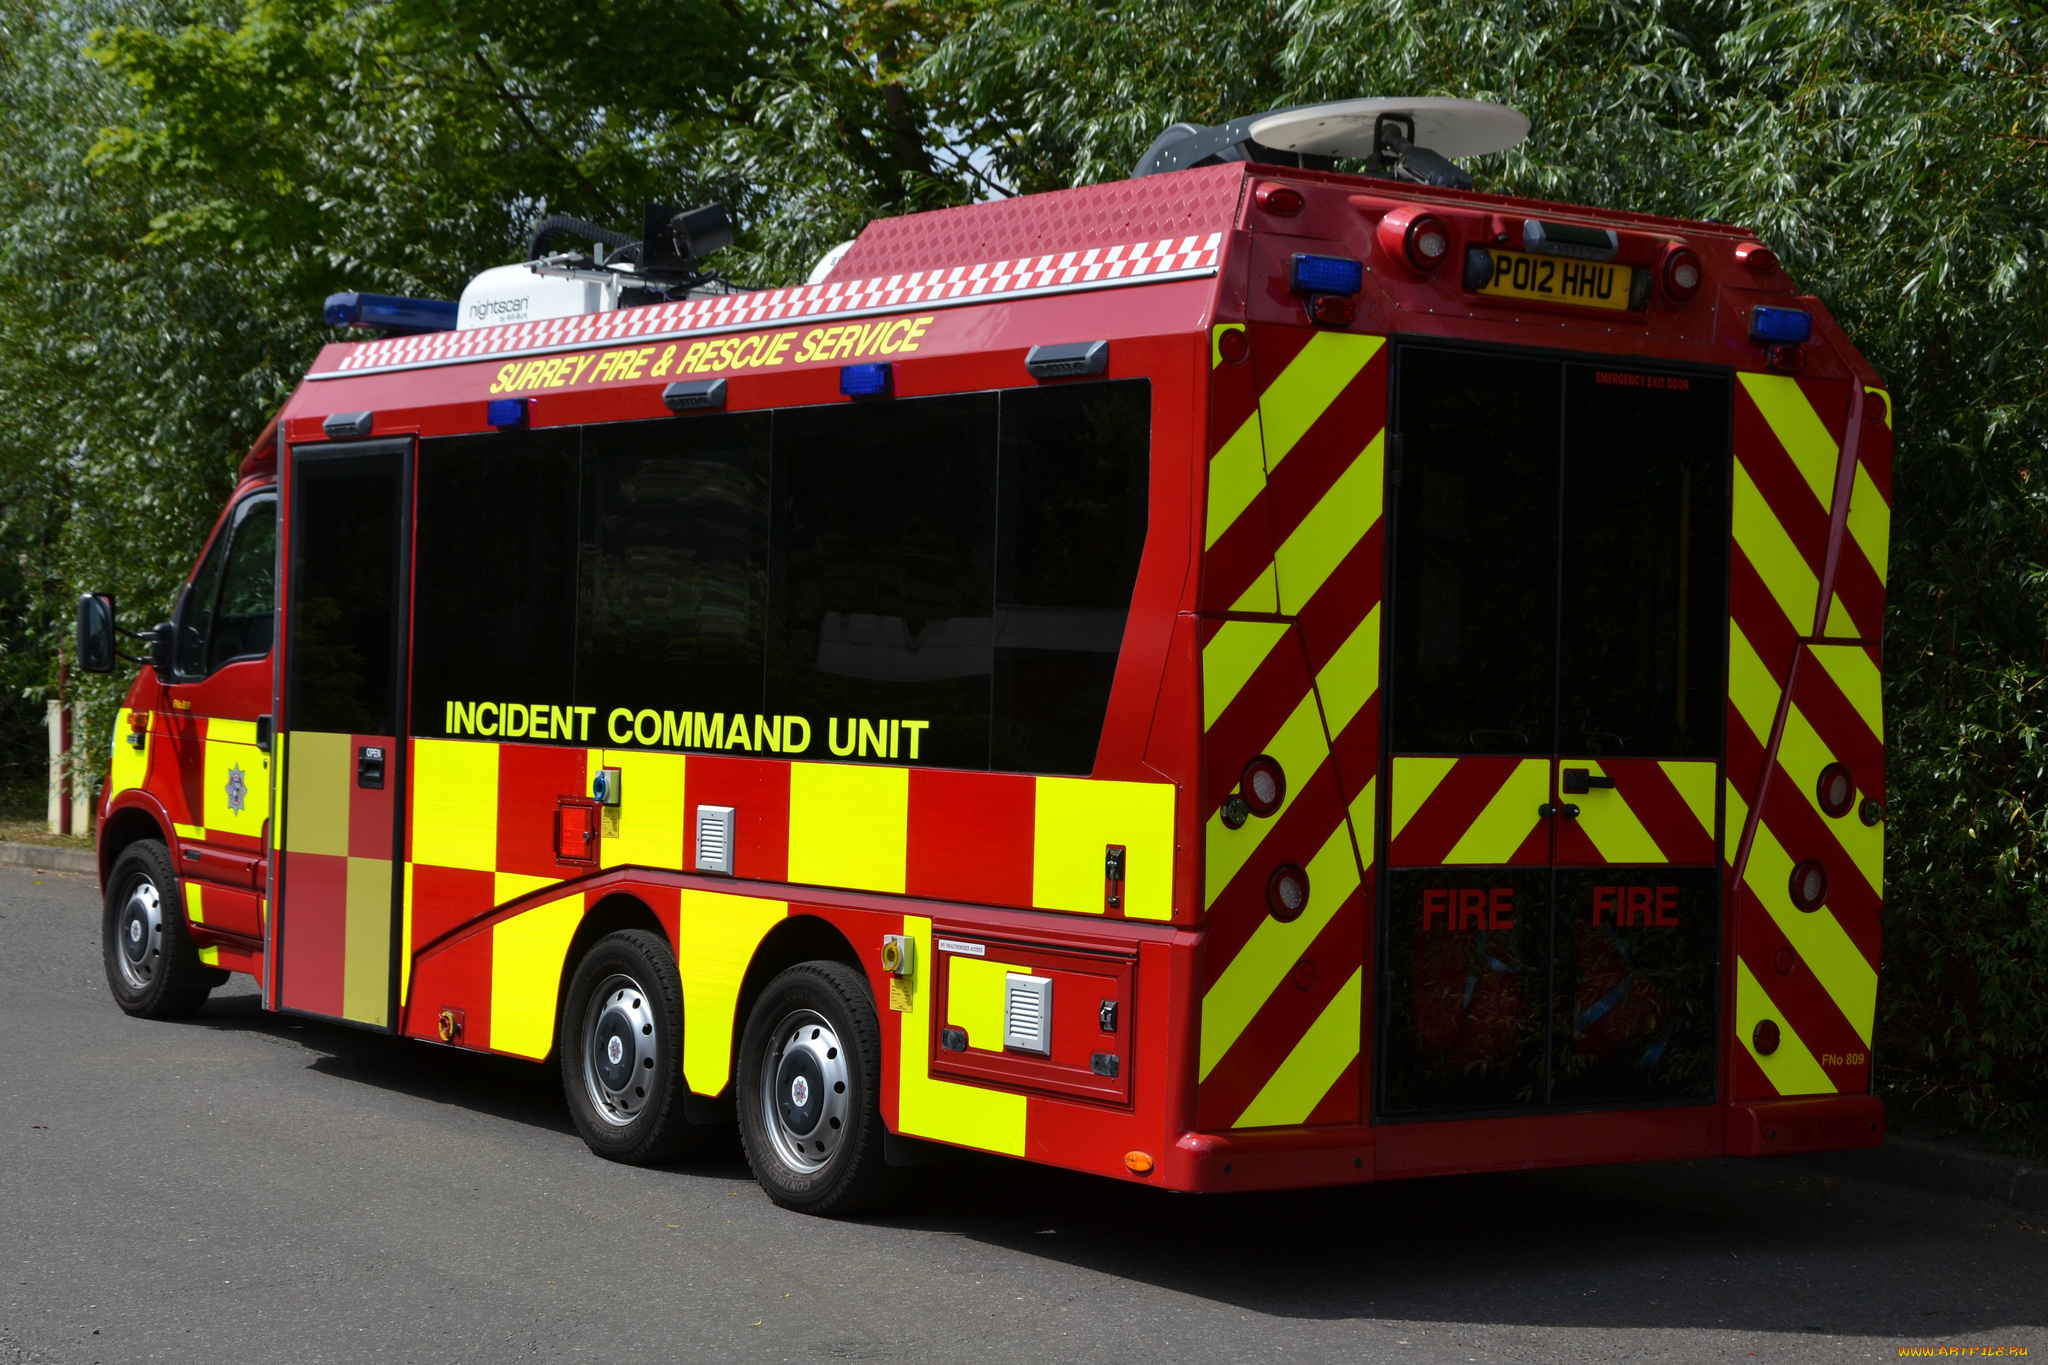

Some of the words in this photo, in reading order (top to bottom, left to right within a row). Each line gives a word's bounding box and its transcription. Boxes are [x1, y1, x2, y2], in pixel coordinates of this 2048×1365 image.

[1494, 255, 1555, 293] PO12
[1561, 263, 1614, 300] HHU
[469, 297, 528, 320] nightscan
[489, 354, 596, 394] SURREY
[587, 347, 656, 384] FIRE
[650, 344, 677, 378] &
[676, 331, 798, 375] RESCUE
[794, 316, 934, 363] SERVICE
[1595, 371, 1645, 387] EMERGENCY
[1647, 376, 1666, 388] EXIT
[1667, 378, 1690, 390] DOOR
[446, 701, 597, 741] INCIDENT
[607, 707, 812, 753] COMMAND
[828, 717, 930, 760] UNIT
[366, 747, 382, 758] OPEN
[1423, 888, 1514, 931] FIRE
[1593, 886, 1679, 927] FIRE
[1822, 1053, 1843, 1066] FNo
[1846, 1053, 1865, 1065] 809
